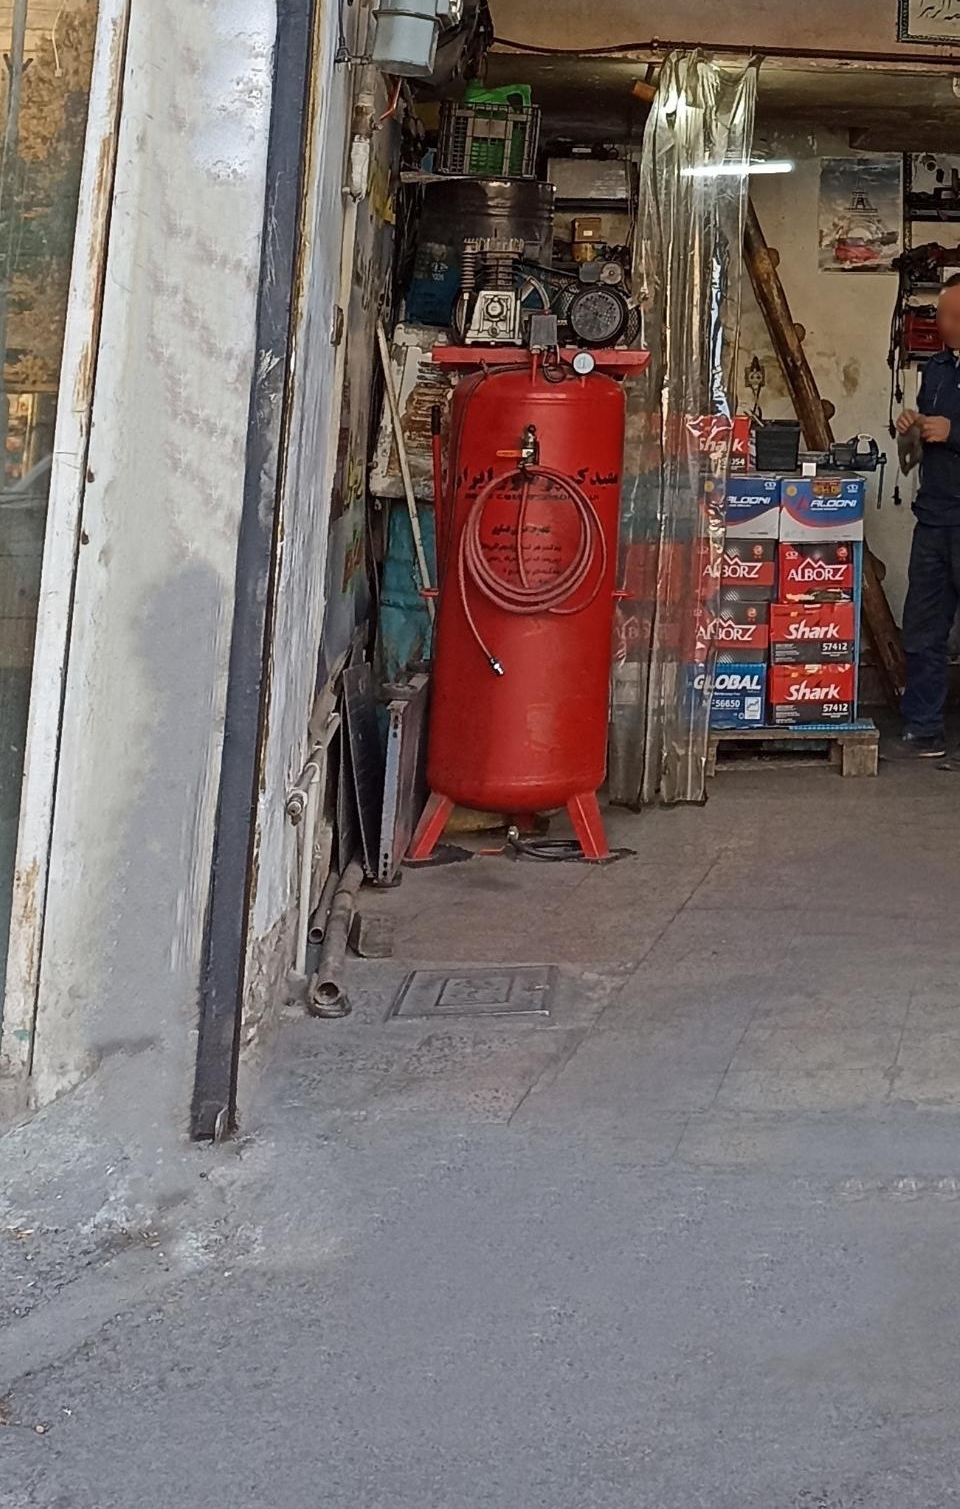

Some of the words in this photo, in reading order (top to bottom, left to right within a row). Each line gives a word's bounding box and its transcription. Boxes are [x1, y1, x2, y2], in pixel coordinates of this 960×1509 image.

[788, 561, 847, 582] ALBORZ
[784, 619, 841, 640] Shark
[822, 642, 848, 652] 57412
[785, 679, 842, 701] Shark
[822, 703, 849, 712] 57412
